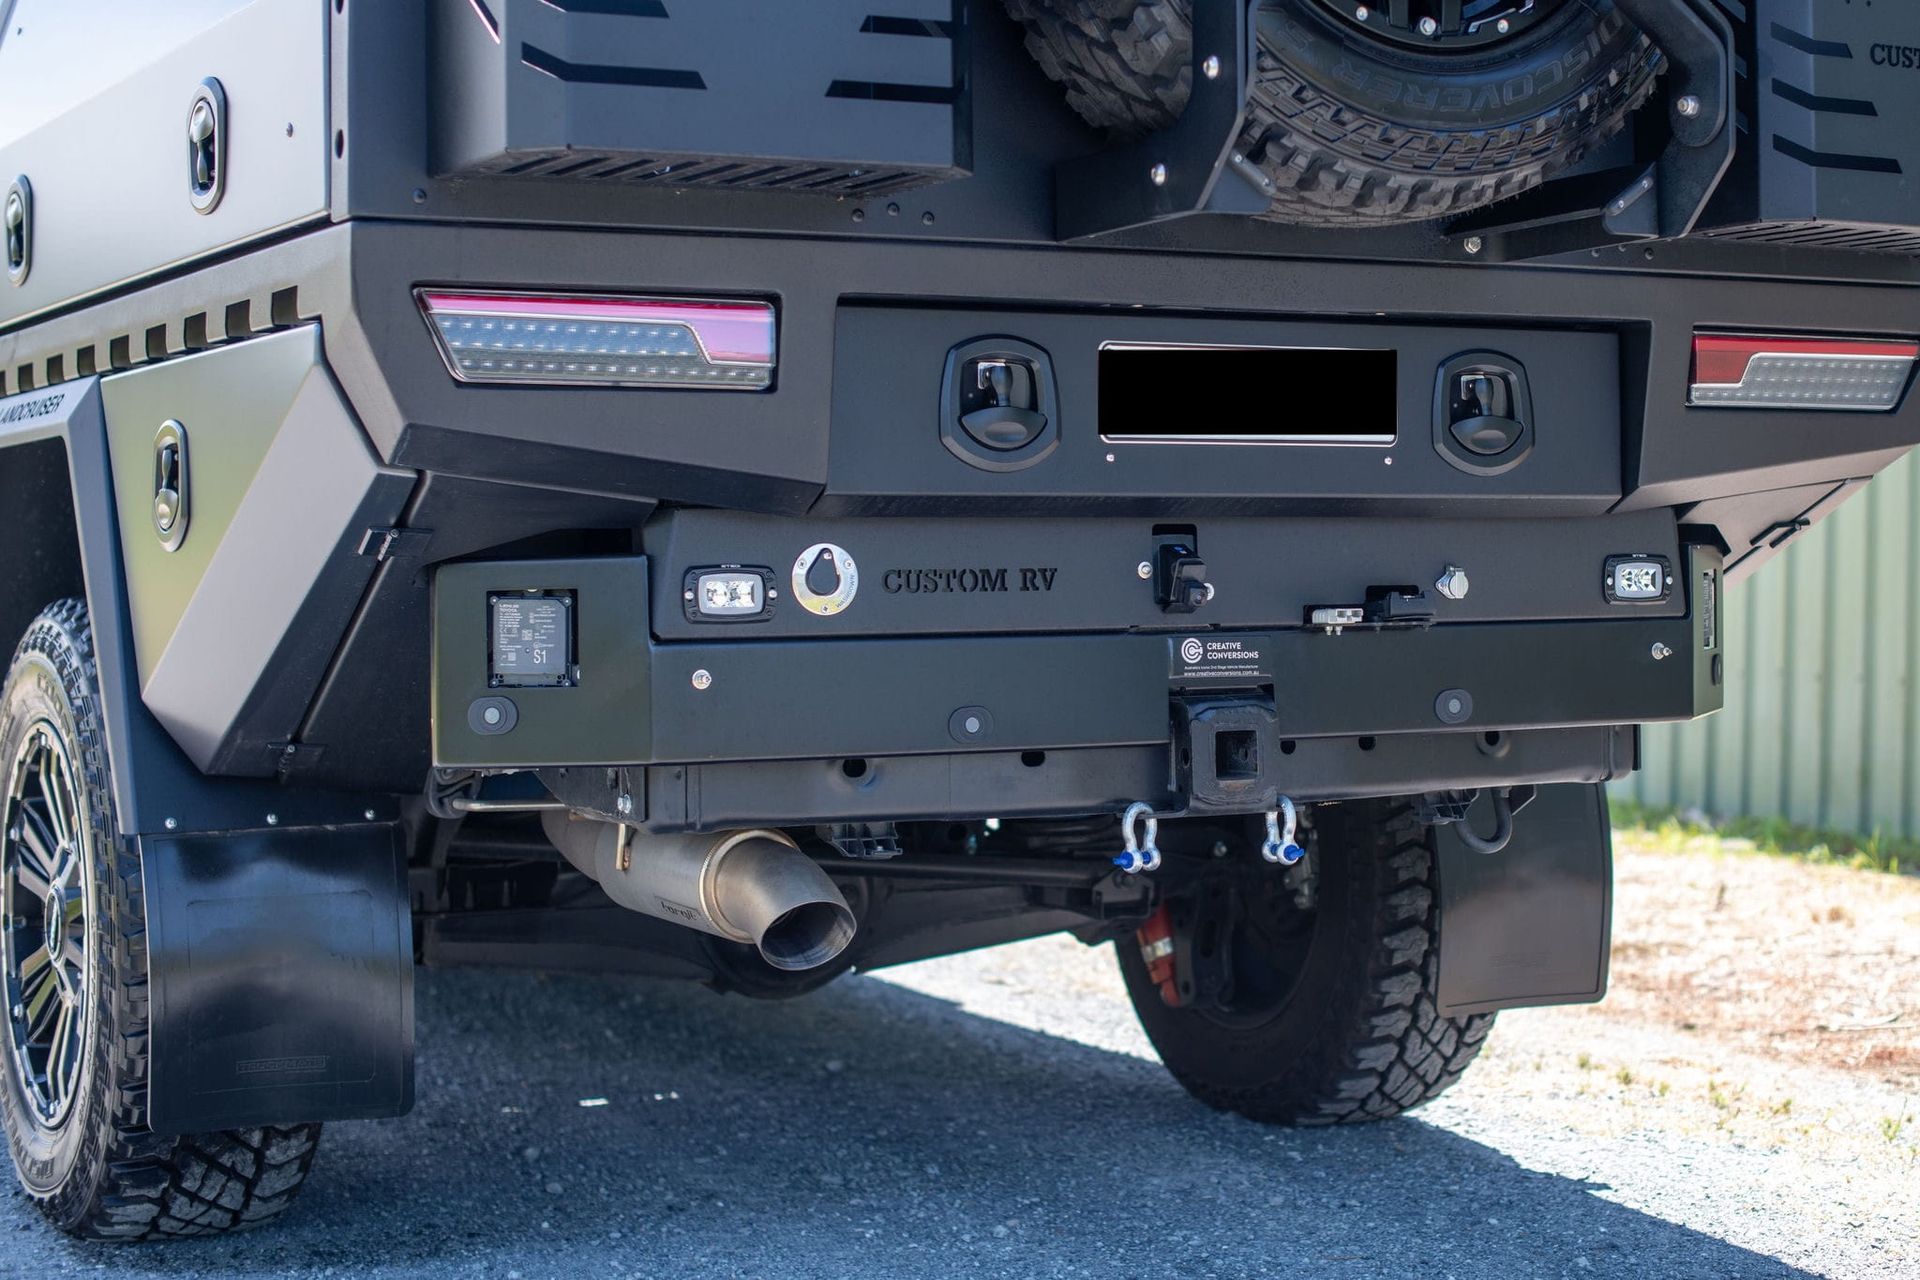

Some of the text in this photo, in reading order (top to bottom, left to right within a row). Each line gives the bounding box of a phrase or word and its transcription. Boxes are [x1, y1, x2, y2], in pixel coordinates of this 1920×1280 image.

[883, 568, 1008, 594] CUSTOM
[1019, 567, 1058, 592] RV
[1207, 642, 1241, 650] CREATIVE
[533, 649, 546, 664] S1
[1207, 651, 1259, 660] CONVERSIONS
